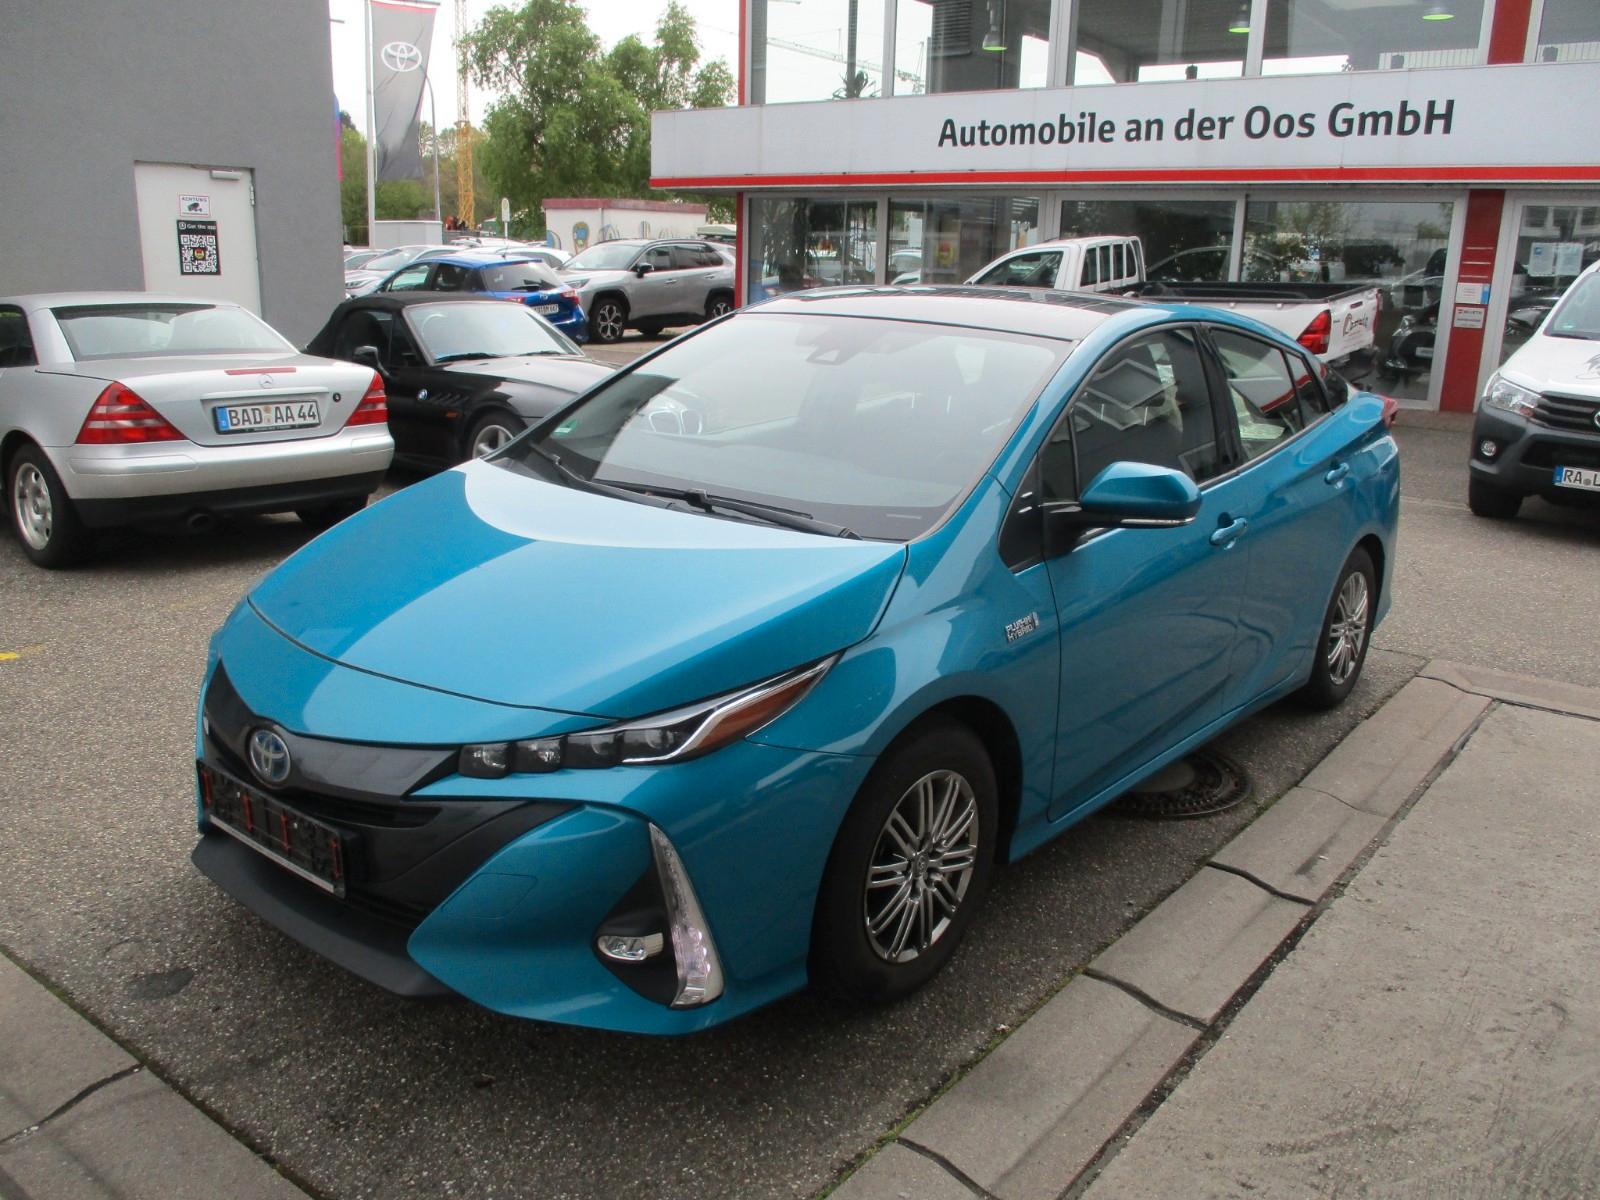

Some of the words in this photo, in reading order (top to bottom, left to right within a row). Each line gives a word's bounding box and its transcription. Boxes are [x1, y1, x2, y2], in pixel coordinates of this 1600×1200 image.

[938, 111, 1116, 147] Automobile
[1125, 117, 1164, 142] an
[1174, 108, 1235, 142] der
[1244, 105, 1316, 139] Oos
[1328, 99, 1455, 137] GmbH
[228, 408, 263, 426] BAD
[274, 406, 295, 423] AA
[297, 404, 317, 421] 44
[1563, 469, 1583, 484] RA
